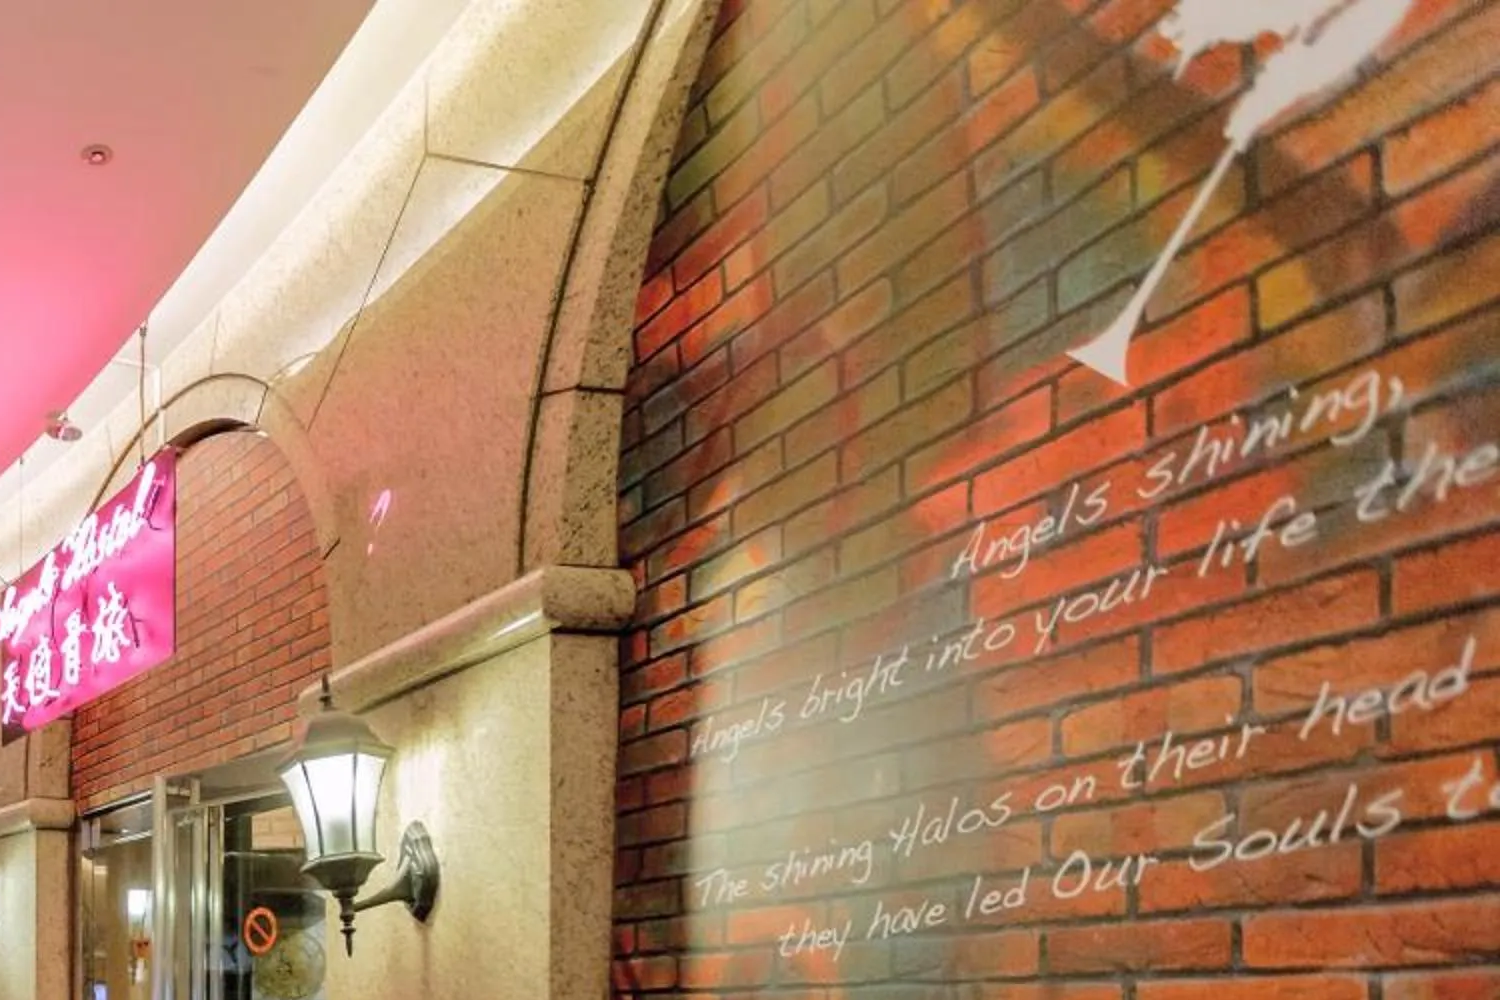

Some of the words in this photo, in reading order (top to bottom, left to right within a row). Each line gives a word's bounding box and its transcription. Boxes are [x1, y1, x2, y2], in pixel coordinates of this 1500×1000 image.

[951, 482, 1109, 580] Angels
[1137, 370, 1404, 498] shining,
[692, 704, 786, 763] Angels
[799, 645, 911, 722] bright
[925, 618, 1015, 672] into
[1034, 562, 1168, 652] your
[1197, 497, 1318, 578] life
[695, 868, 749, 908] The
[762, 837, 874, 892] shining
[890, 792, 1014, 857] Halos
[1035, 773, 1098, 814] on
[1119, 714, 1266, 791] their
[1300, 634, 1476, 741] head
[779, 919, 852, 961] they
[867, 901, 948, 940] have
[965, 868, 1028, 920] led
[1052, 849, 1159, 900] Our
[1190, 783, 1403, 871] Souls
[1441, 753, 1500, 820] t
